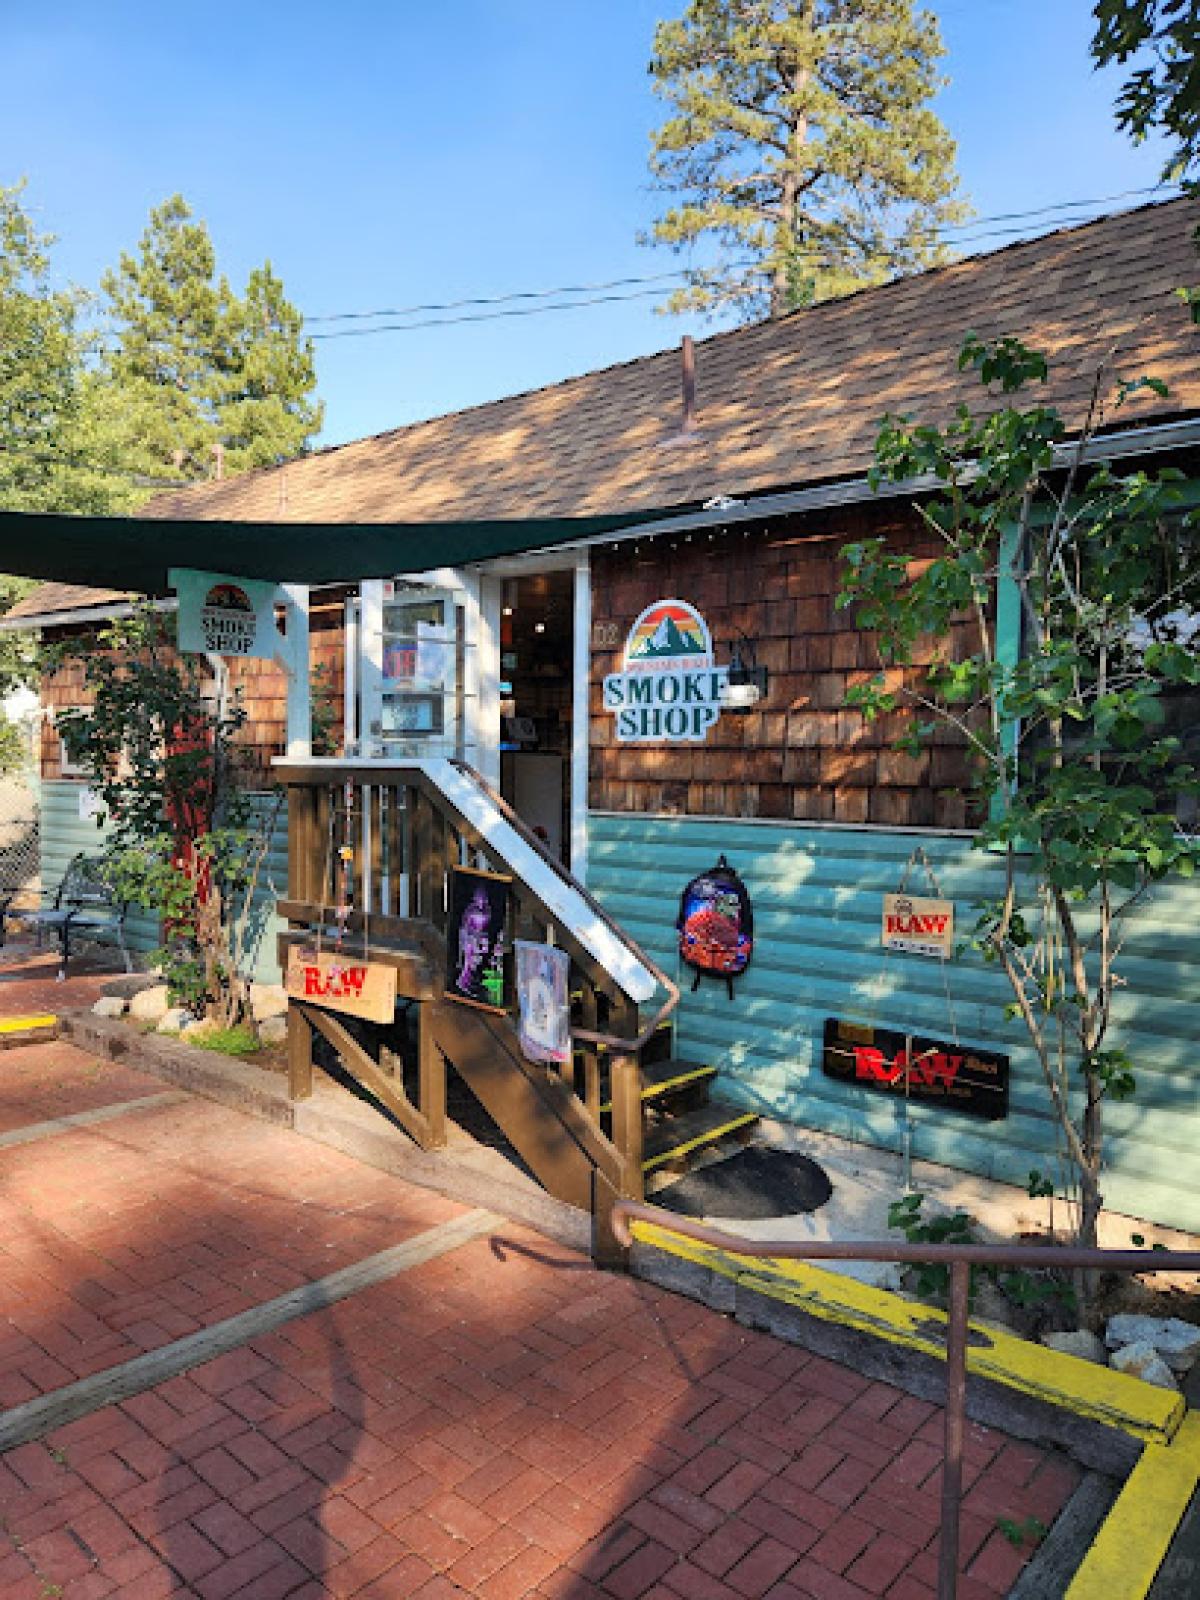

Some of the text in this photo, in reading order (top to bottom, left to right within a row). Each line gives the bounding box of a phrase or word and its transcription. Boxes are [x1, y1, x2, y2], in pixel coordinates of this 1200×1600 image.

[201, 617, 256, 636] SMOKE
[205, 635, 254, 654] SHOP
[605, 672, 727, 706] SMOKE
[619, 705, 715, 736] SHOP
[885, 914, 950, 934] RAW
[852, 1046, 963, 1087] RAW
